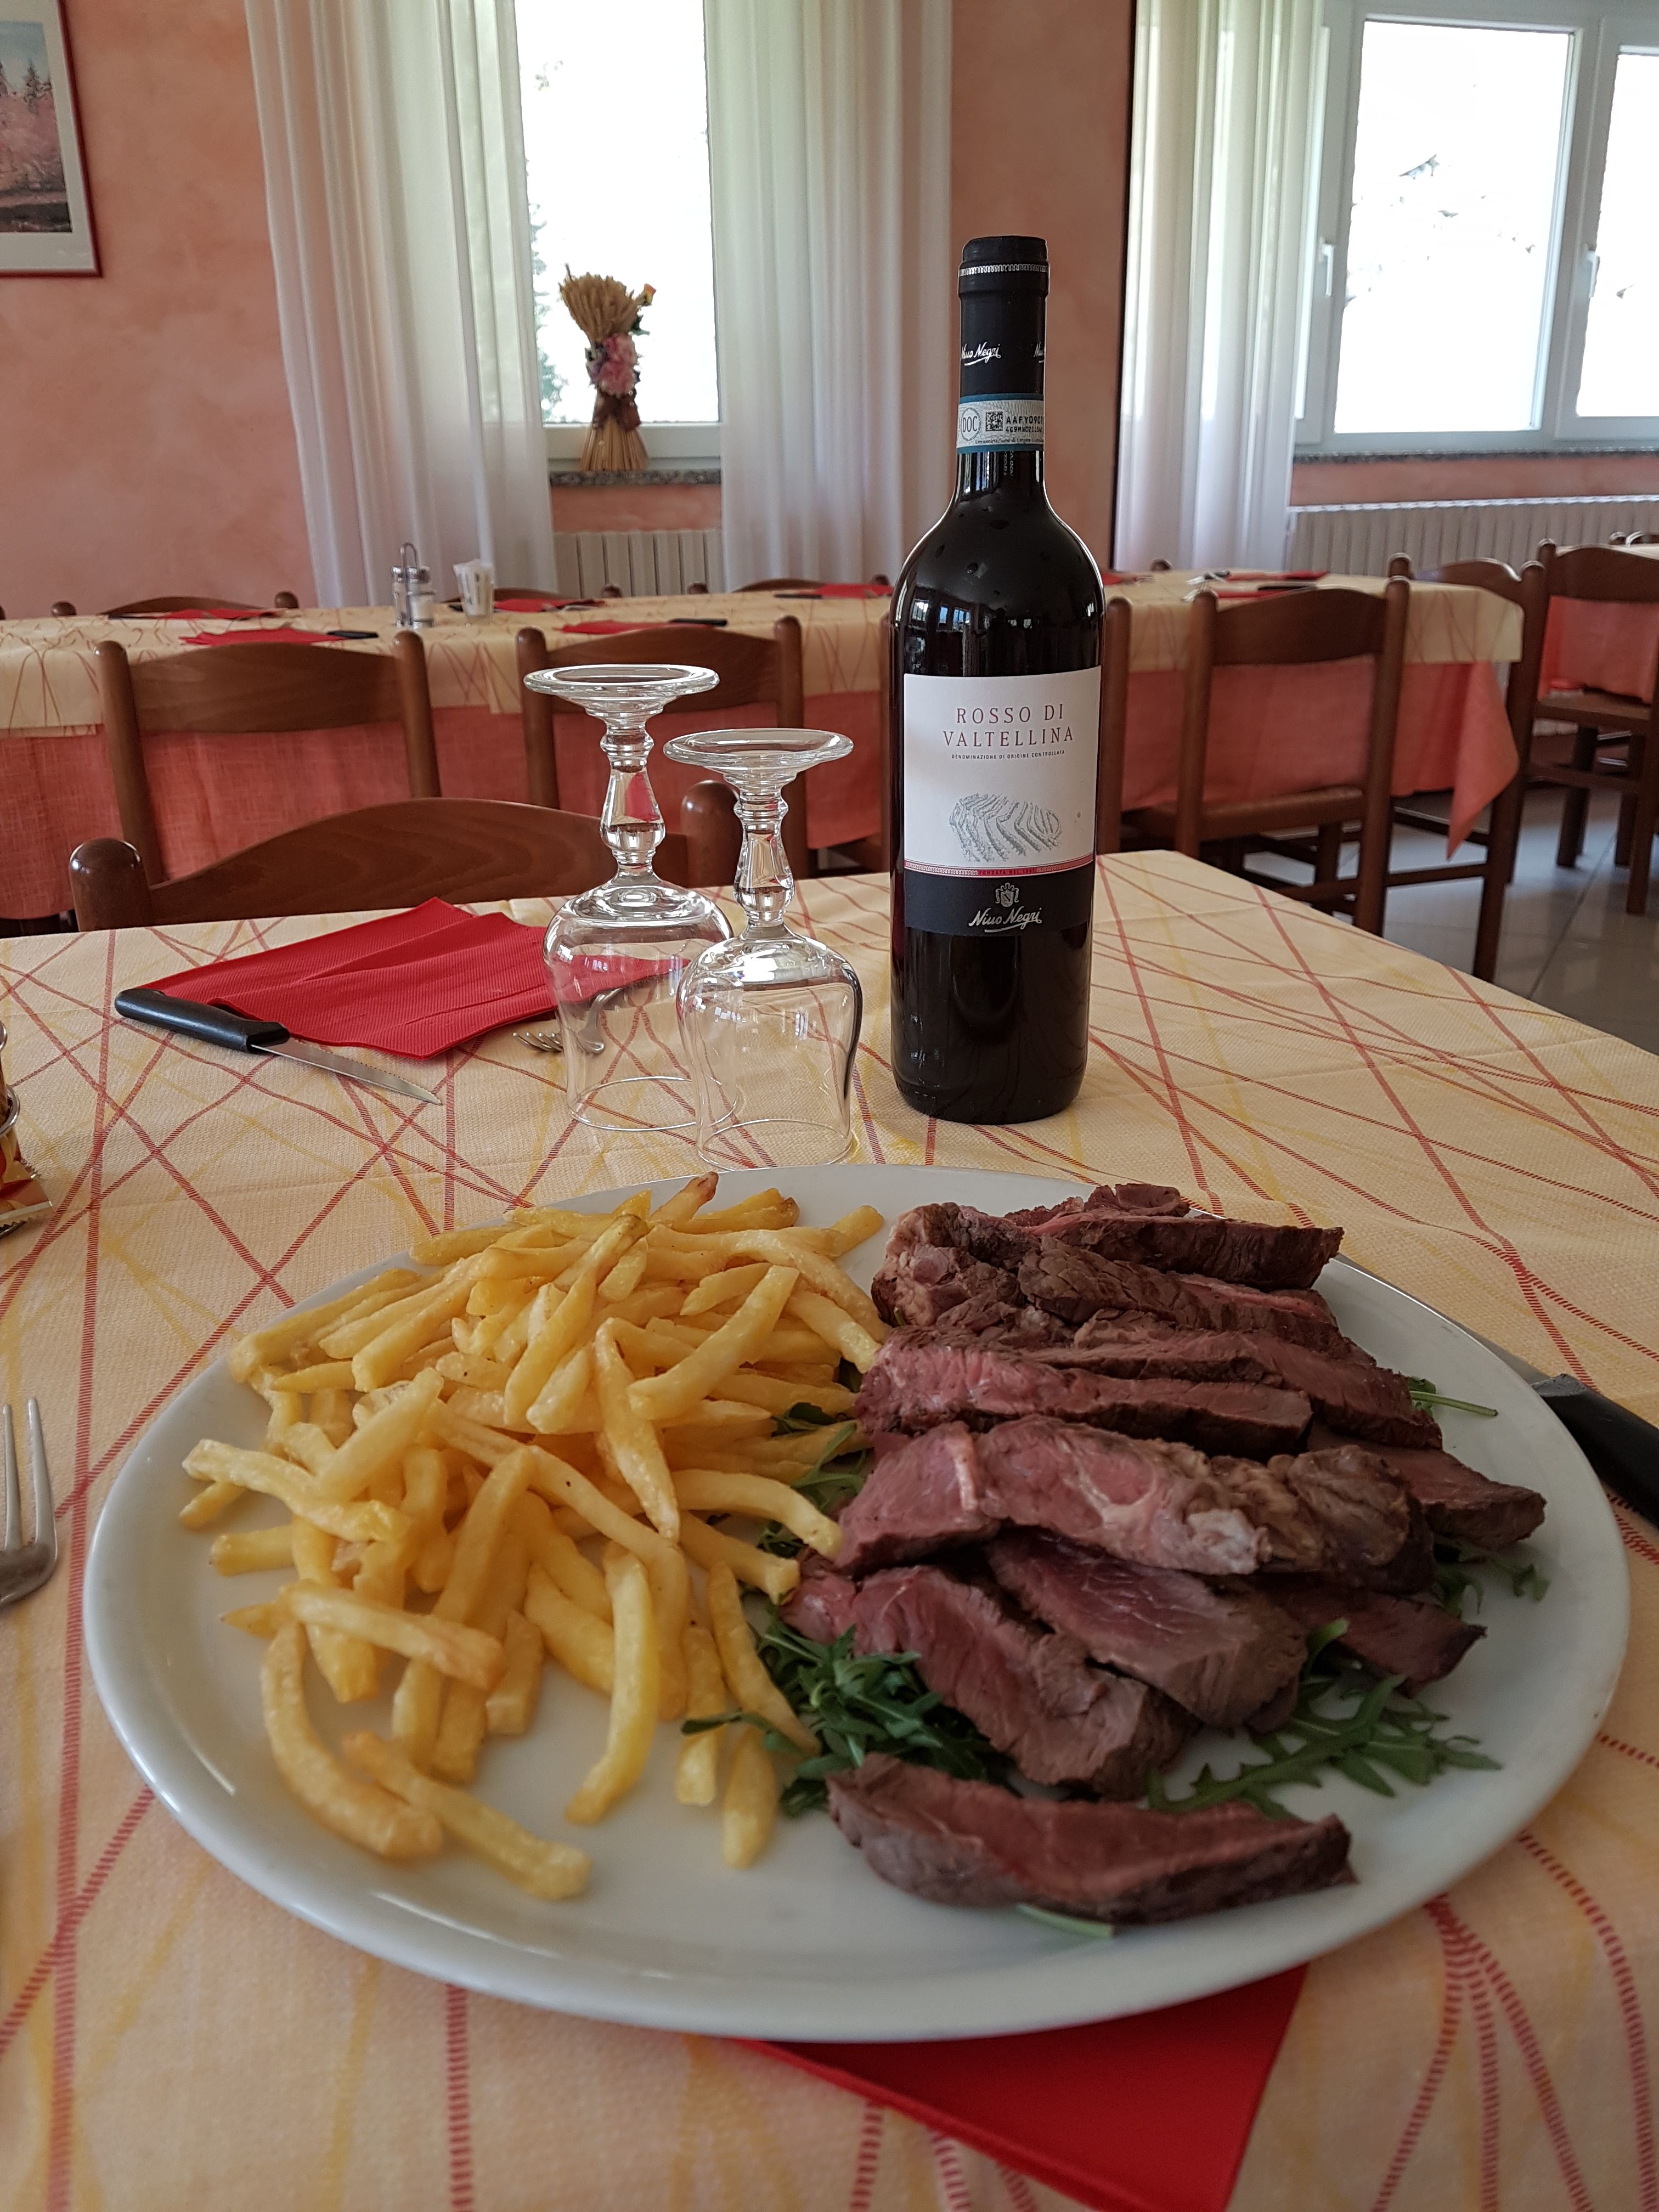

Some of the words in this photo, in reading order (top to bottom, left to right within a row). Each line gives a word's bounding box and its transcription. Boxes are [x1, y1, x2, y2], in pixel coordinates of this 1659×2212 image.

[973, 341, 1001, 363] Negri
[962, 415, 978, 433] DOC
[956, 706, 1031, 724] ROSSO
[1044, 703, 1063, 721] DI
[943, 726, 1074, 747] VALTELLINA
[1031, 749, 1065, 758] CONTROLLATA
[1003, 906, 1042, 930] Negri
